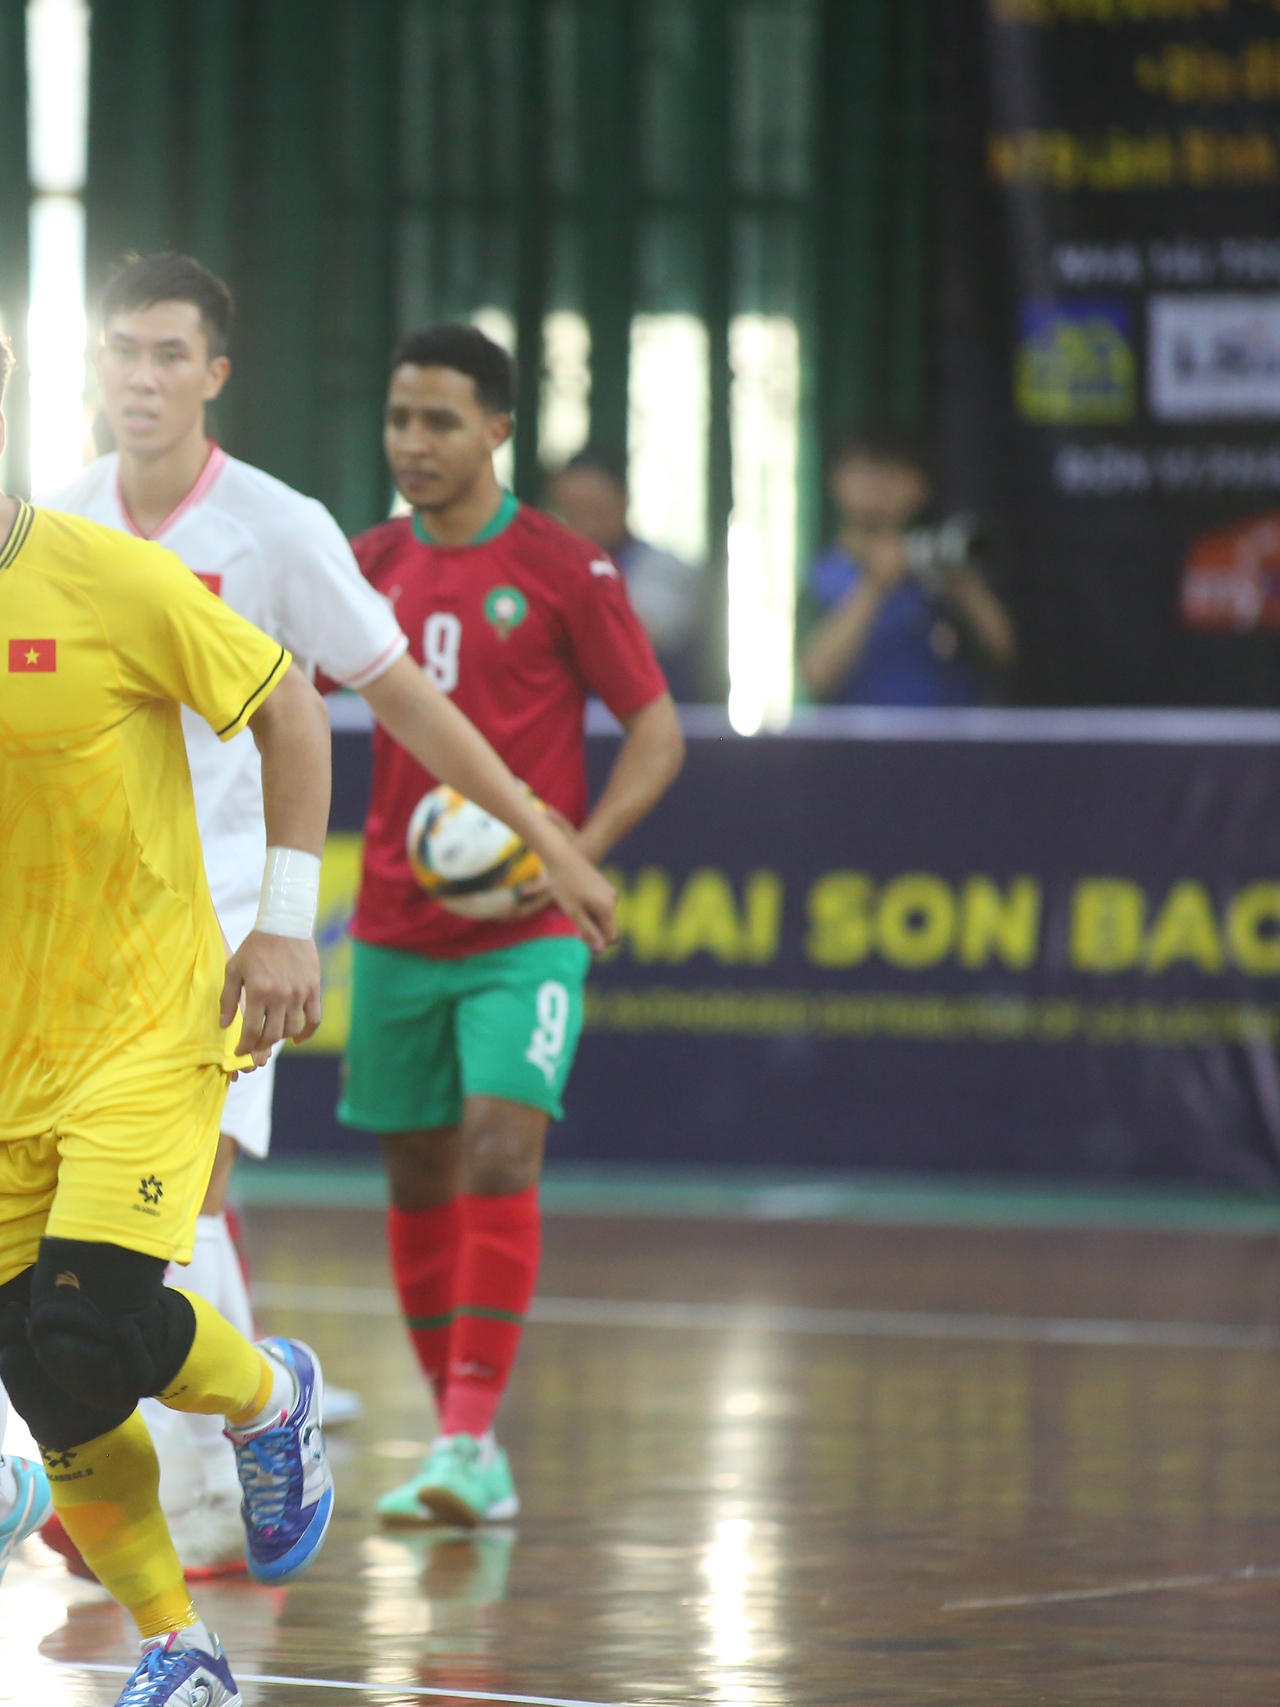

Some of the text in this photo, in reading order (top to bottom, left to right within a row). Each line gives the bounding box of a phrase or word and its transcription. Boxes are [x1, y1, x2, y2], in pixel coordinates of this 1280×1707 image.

[423, 612, 462, 692] 9
[594, 868, 782, 965] HAI
[805, 870, 1041, 970] SON
[532, 981, 568, 1057] 9
